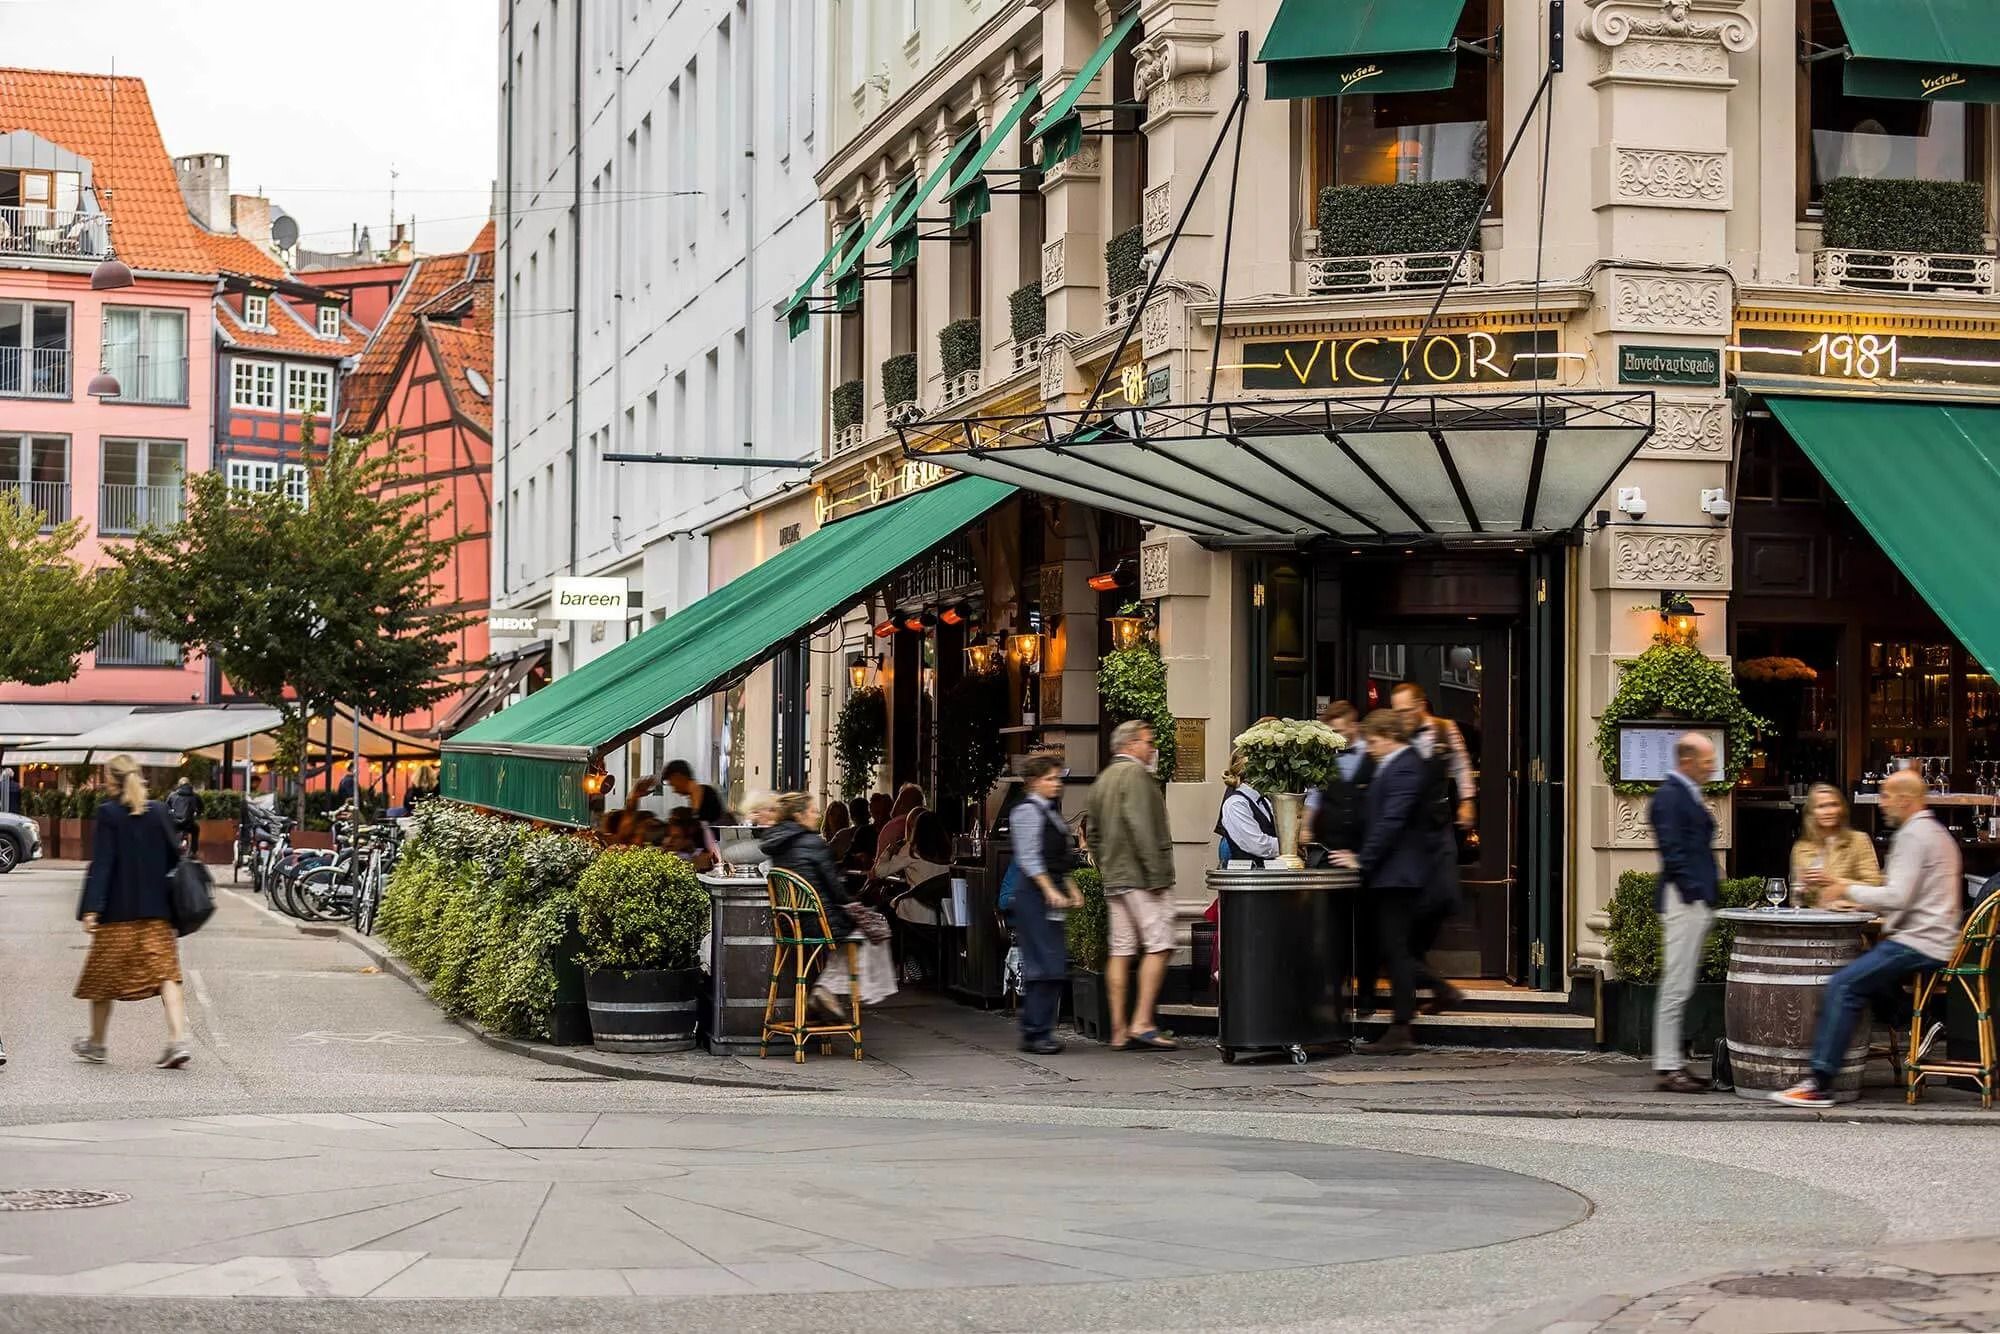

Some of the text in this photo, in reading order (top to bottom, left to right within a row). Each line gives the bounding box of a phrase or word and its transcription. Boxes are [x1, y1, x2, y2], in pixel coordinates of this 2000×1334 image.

[1285, 332, 1509, 384] VICTOR
[1624, 352, 1715, 375] Hovedvagtsgade
[1808, 334, 1897, 379] 1981
[560, 591, 621, 606] bareen
